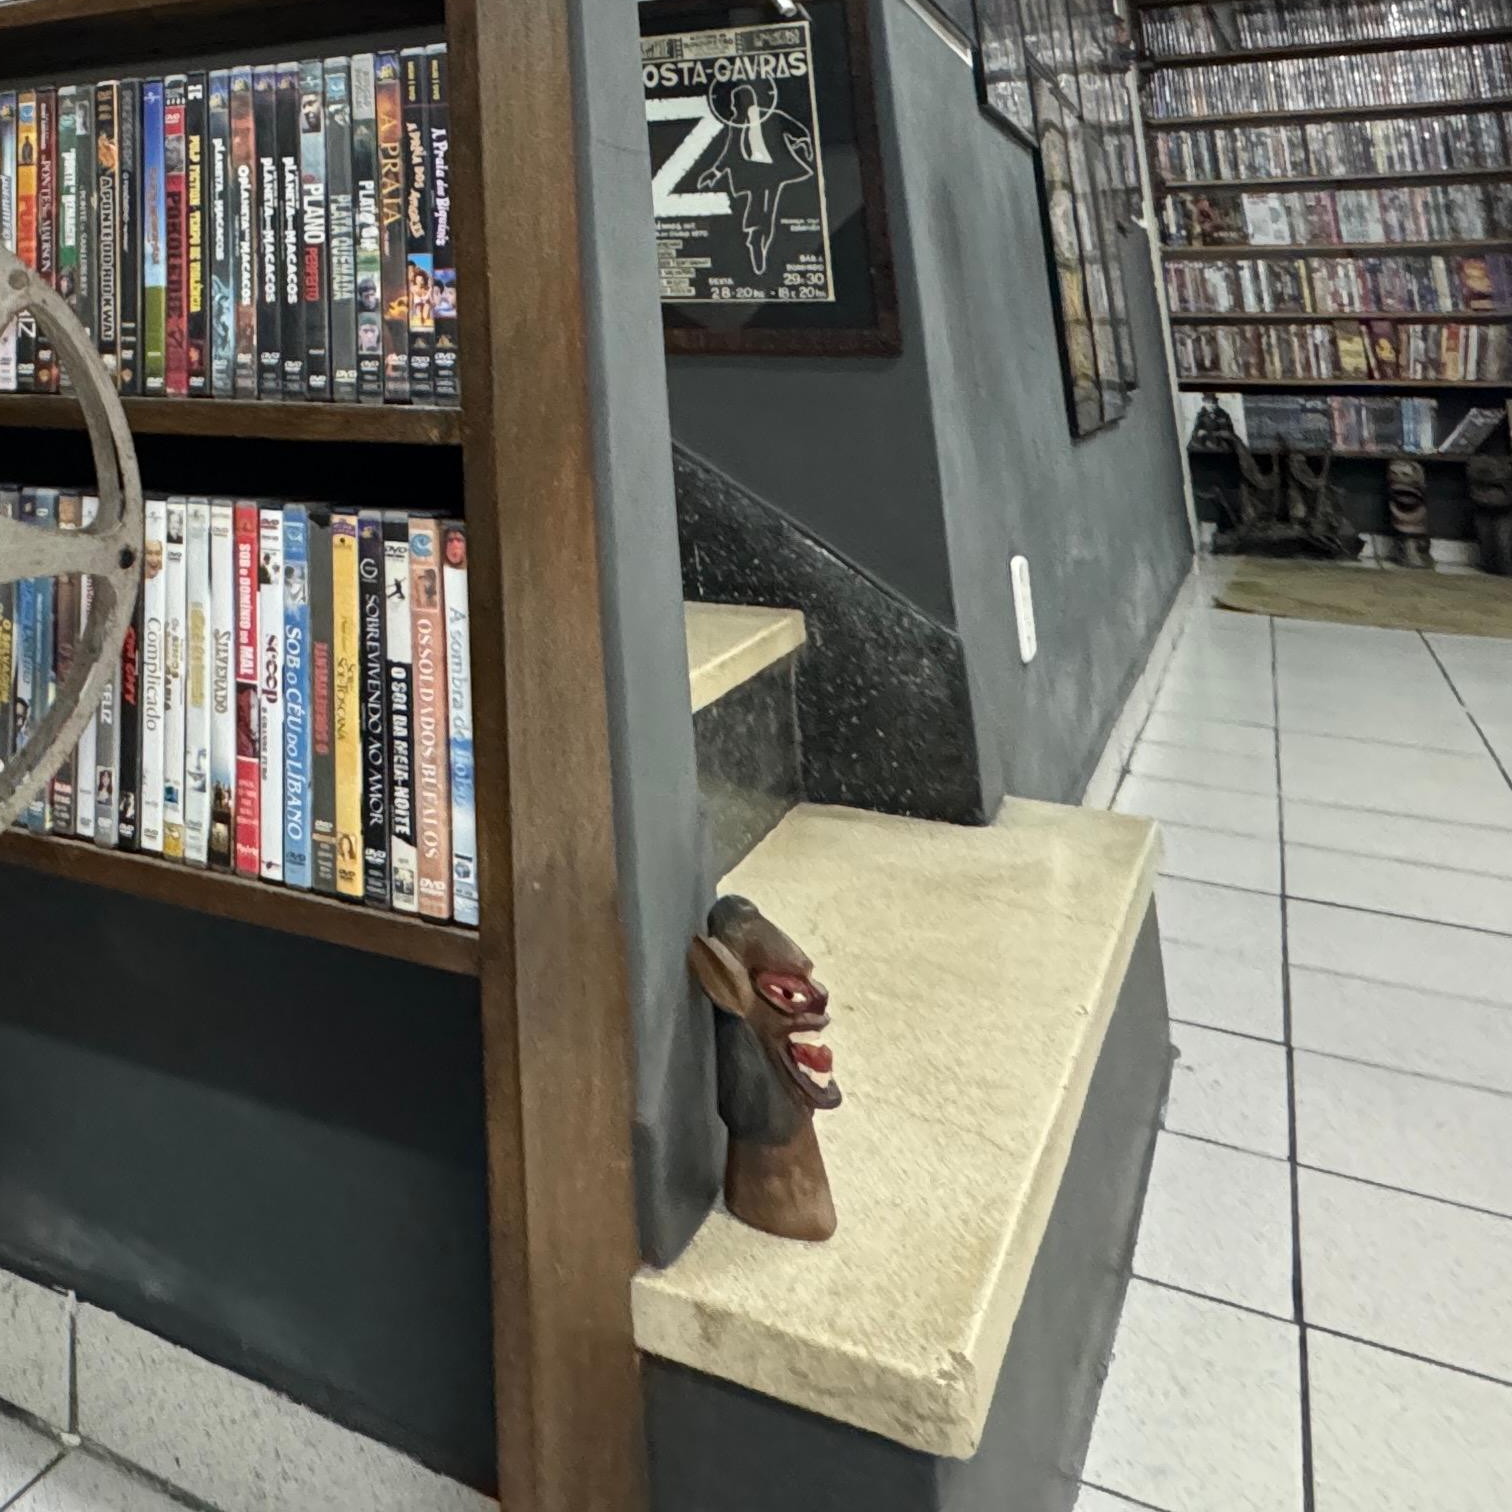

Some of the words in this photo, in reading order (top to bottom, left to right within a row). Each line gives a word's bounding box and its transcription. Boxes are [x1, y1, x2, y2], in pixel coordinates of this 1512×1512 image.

[380, 113, 396, 128] A
[431, 128, 445, 137] A
[189, 135, 201, 162] PULP
[432, 140, 448, 175] Praia
[645, 95, 732, 218] Z
[100, 176, 111, 187] A
[381, 141, 401, 226] PRAIA
[100, 191, 112, 239] PONTE
[304, 183, 324, 243] PLANO
[330, 194, 353, 235] PLATA
[101, 269, 113, 293] RIO
[263, 230, 275, 303] MACACOS
[286, 230, 298, 303] MACACOS
[238, 543, 252, 566] SOB
[238, 576, 253, 628] DOMÍNIO
[239, 646, 255, 675] MAL
[286, 625, 304, 668] SOB
[365, 594, 381, 732] SOBREVIVENDO
[145, 617, 162, 731] Complicado
[391, 667, 406, 677] O
[287, 688, 306, 727] CÉU
[392, 681, 407, 710] SOL
[393, 714, 407, 734] DA
[368, 737, 382, 766] AO
[286, 760, 305, 840] LÍBANO
[368, 770, 384, 826] AMOR
[393, 740, 411, 835] MEIA-NOITE
